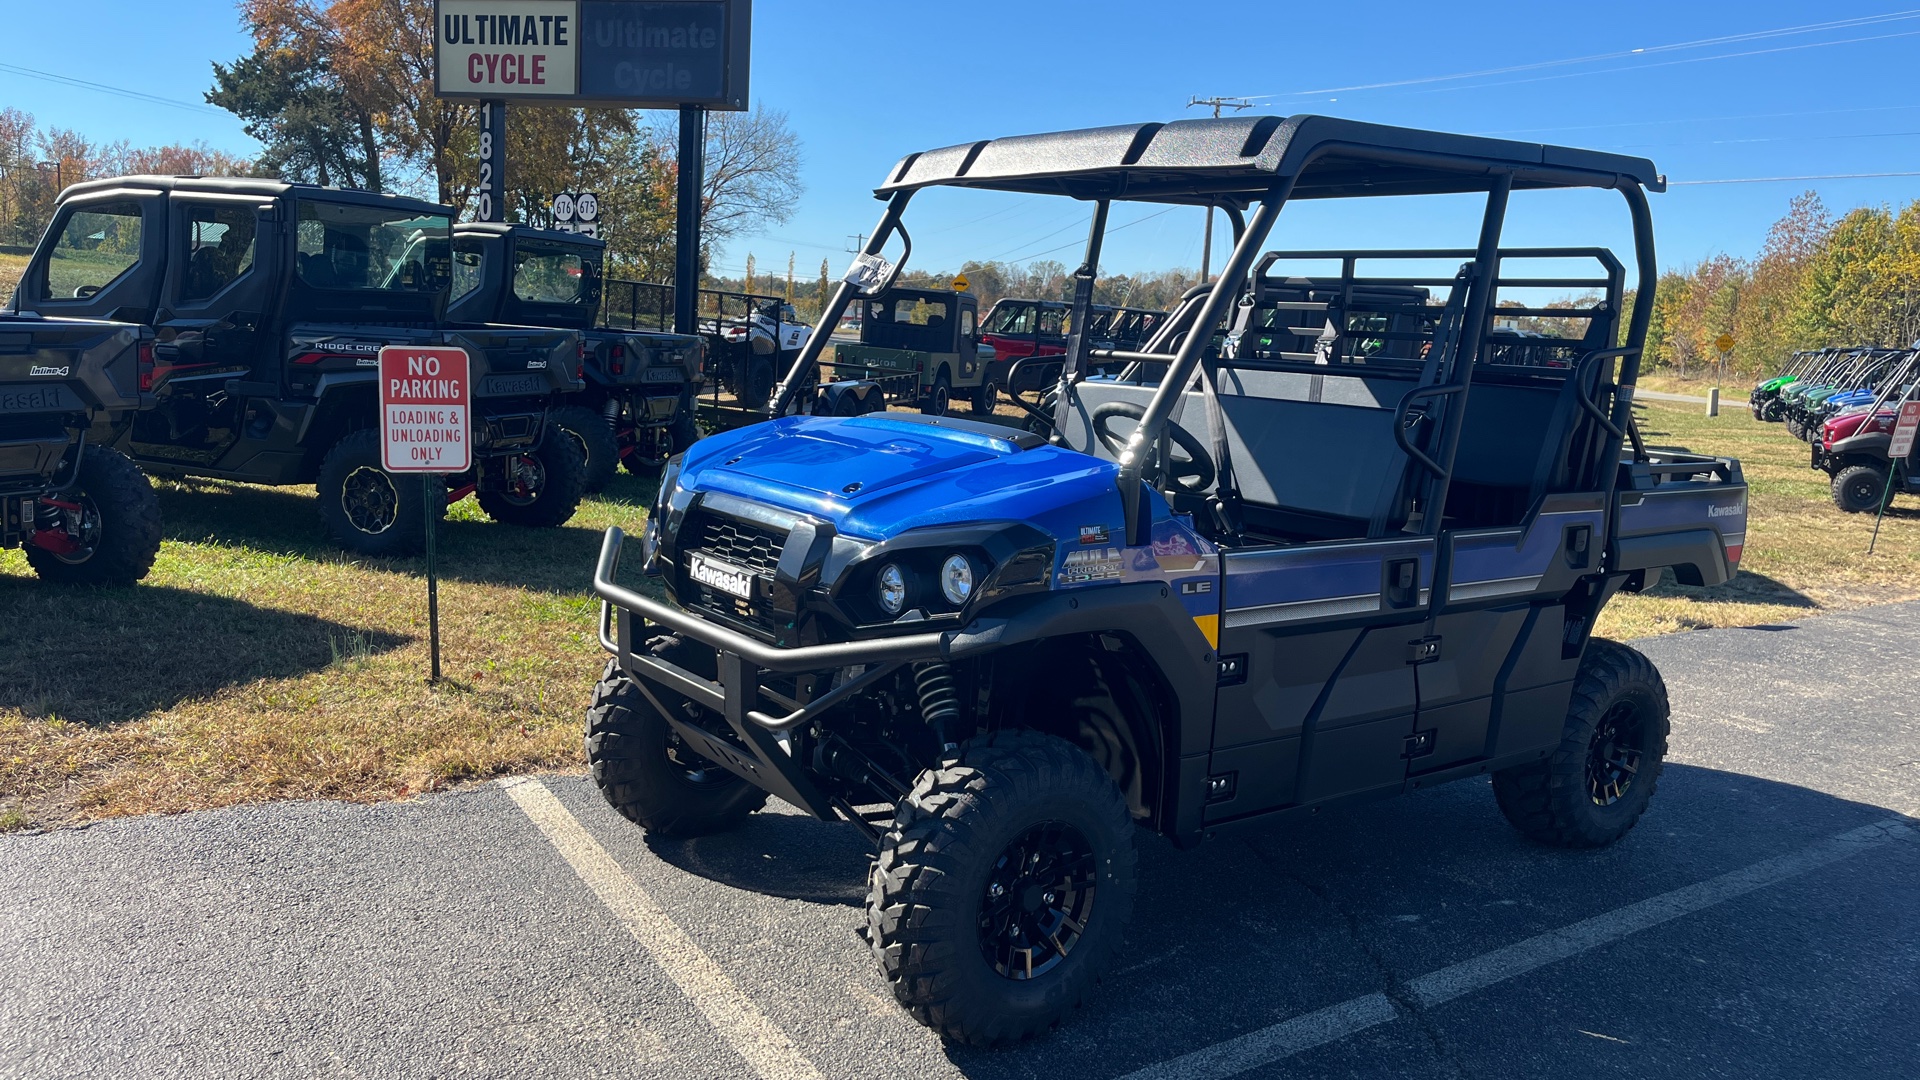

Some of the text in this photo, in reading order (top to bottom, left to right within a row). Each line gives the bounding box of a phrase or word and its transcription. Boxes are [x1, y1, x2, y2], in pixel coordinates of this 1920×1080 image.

[444, 15, 568, 46] ULTIMATE
[595, 19, 717, 49] Ultimate
[468, 53, 546, 85] CYCLE
[614, 61, 692, 95] Cycle
[480, 102, 492, 221] 1820
[556, 201, 571, 214] 676
[580, 200, 595, 214] 675
[315, 342, 384, 352] RIDGE CRE
[30, 365, 69, 376] Inline-4
[408, 356, 441, 377] NO
[390, 378, 460, 399] PARKING
[487, 376, 541, 394] Kawasaki
[0, 388, 61, 410] asaki
[392, 410, 459, 425] LOADING &
[391, 429, 461, 443] UNLOADING
[411, 447, 443, 461] ONLY
[1708, 502, 1743, 518] Kawasaki
[1080, 525, 1101, 536] ULTIMATE
[690, 556, 752, 598] Kawasaki
[1182, 581, 1211, 594] LE
